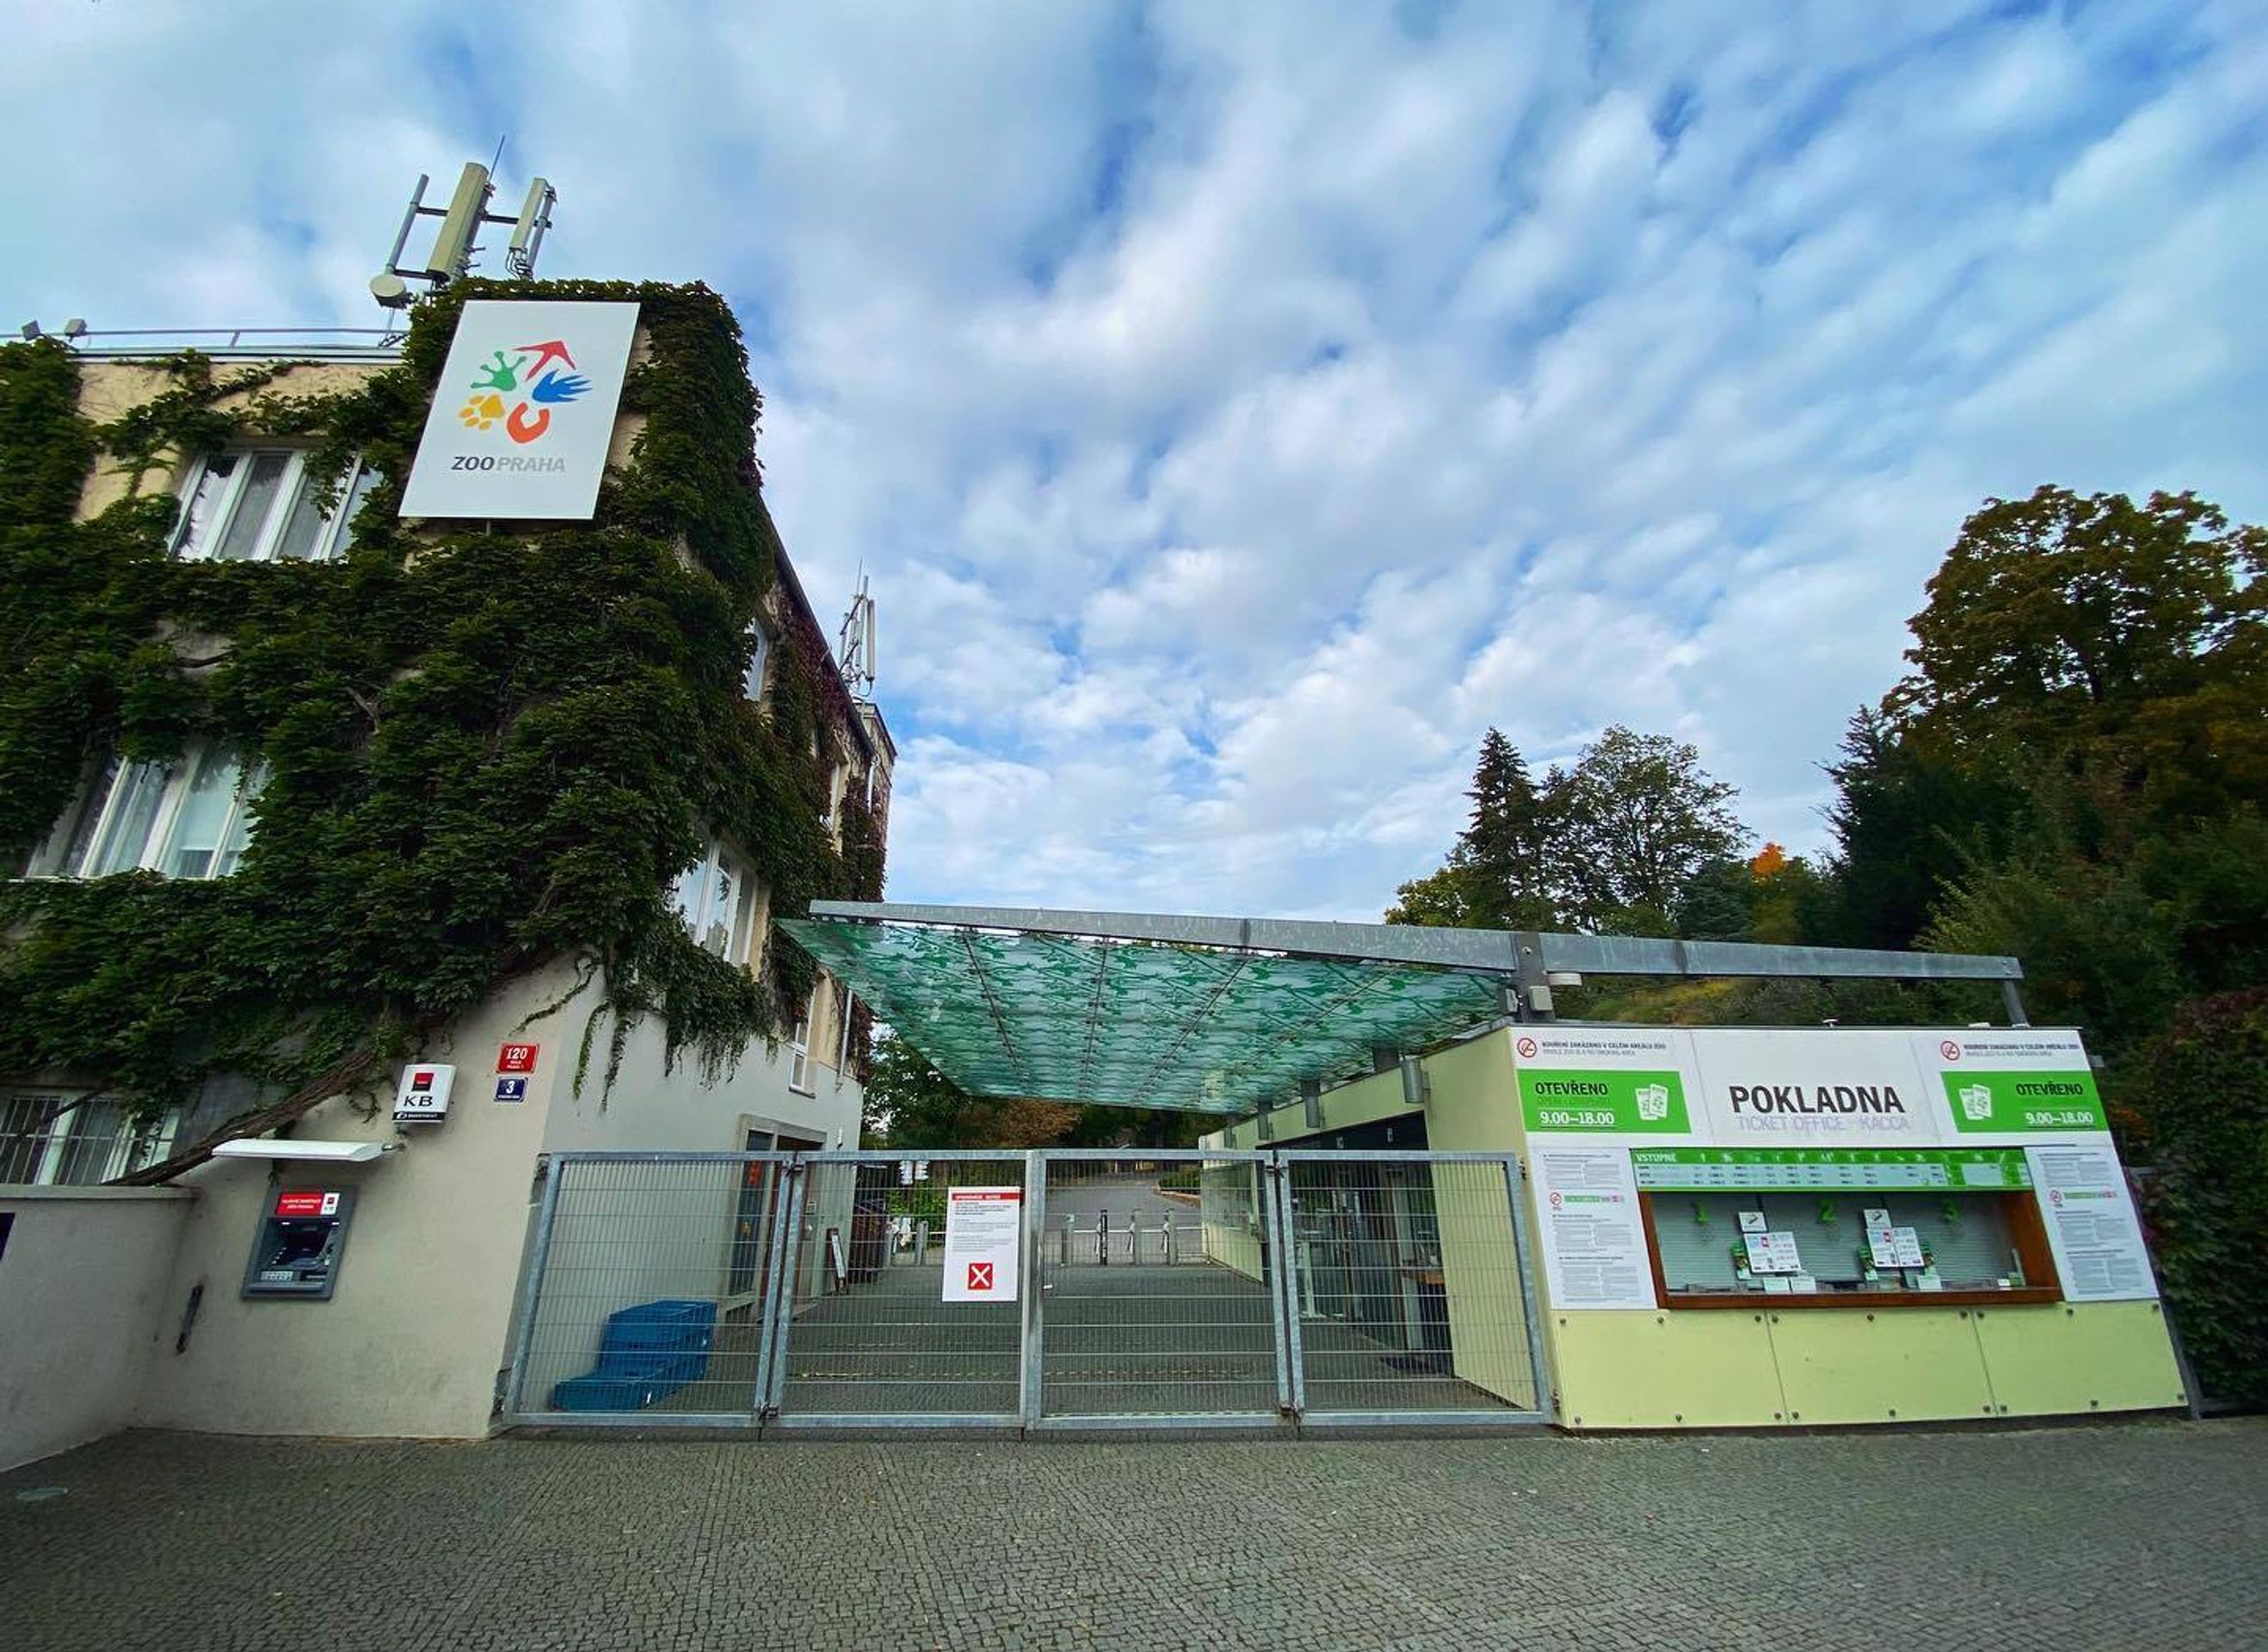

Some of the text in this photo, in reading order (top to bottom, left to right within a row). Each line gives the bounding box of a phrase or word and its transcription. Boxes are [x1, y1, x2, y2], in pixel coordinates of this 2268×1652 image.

[451, 456, 565, 472] ZOO PRAHA
[505, 1047, 528, 1060] 120
[505, 1080, 515, 1094] 3
[1535, 1080, 1608, 1095] OTEVŘENO
[2016, 1080, 2084, 1095] OTEVŘENO
[403, 1095, 433, 1106] KB
[1729, 1085, 1906, 1113] POKLADNA
[1737, 1116, 1846, 1131] TICKET OFFICE
